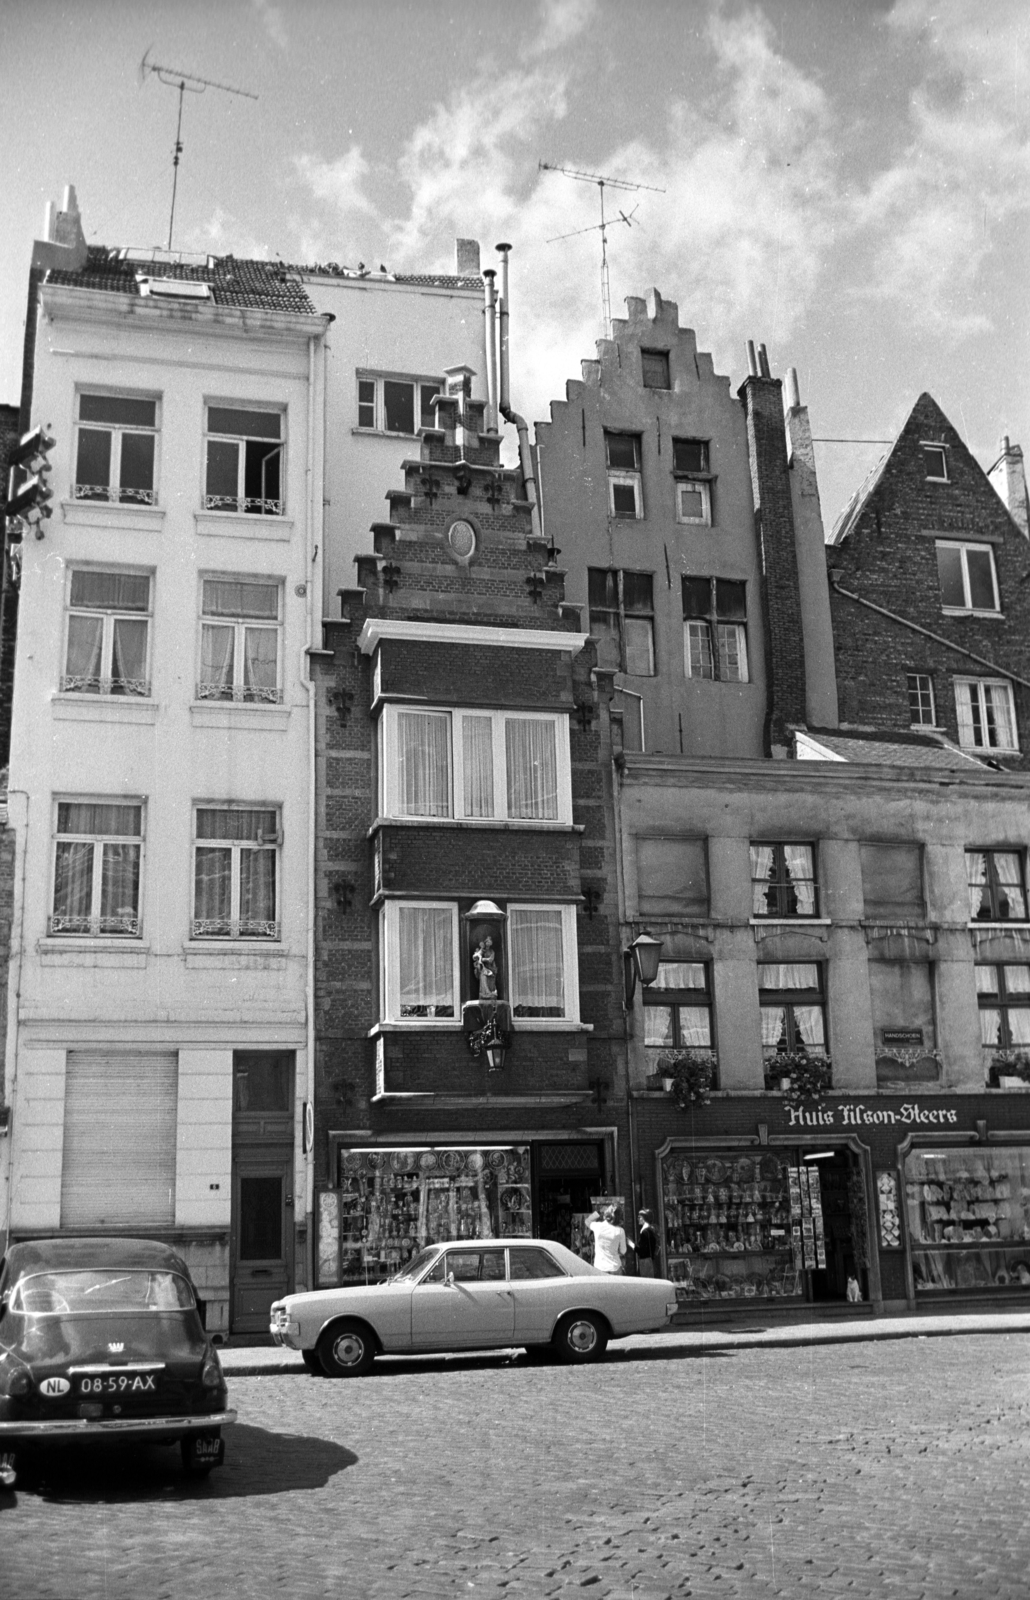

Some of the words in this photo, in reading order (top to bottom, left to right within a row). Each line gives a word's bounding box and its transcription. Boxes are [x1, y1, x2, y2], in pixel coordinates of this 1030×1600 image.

[784, 1105, 834, 1126] Huis
[46, 1379, 64, 1395] NL
[80, 1374, 156, 1393] 08-59-AX
[195, 1438, 221, 1455] SAAB
